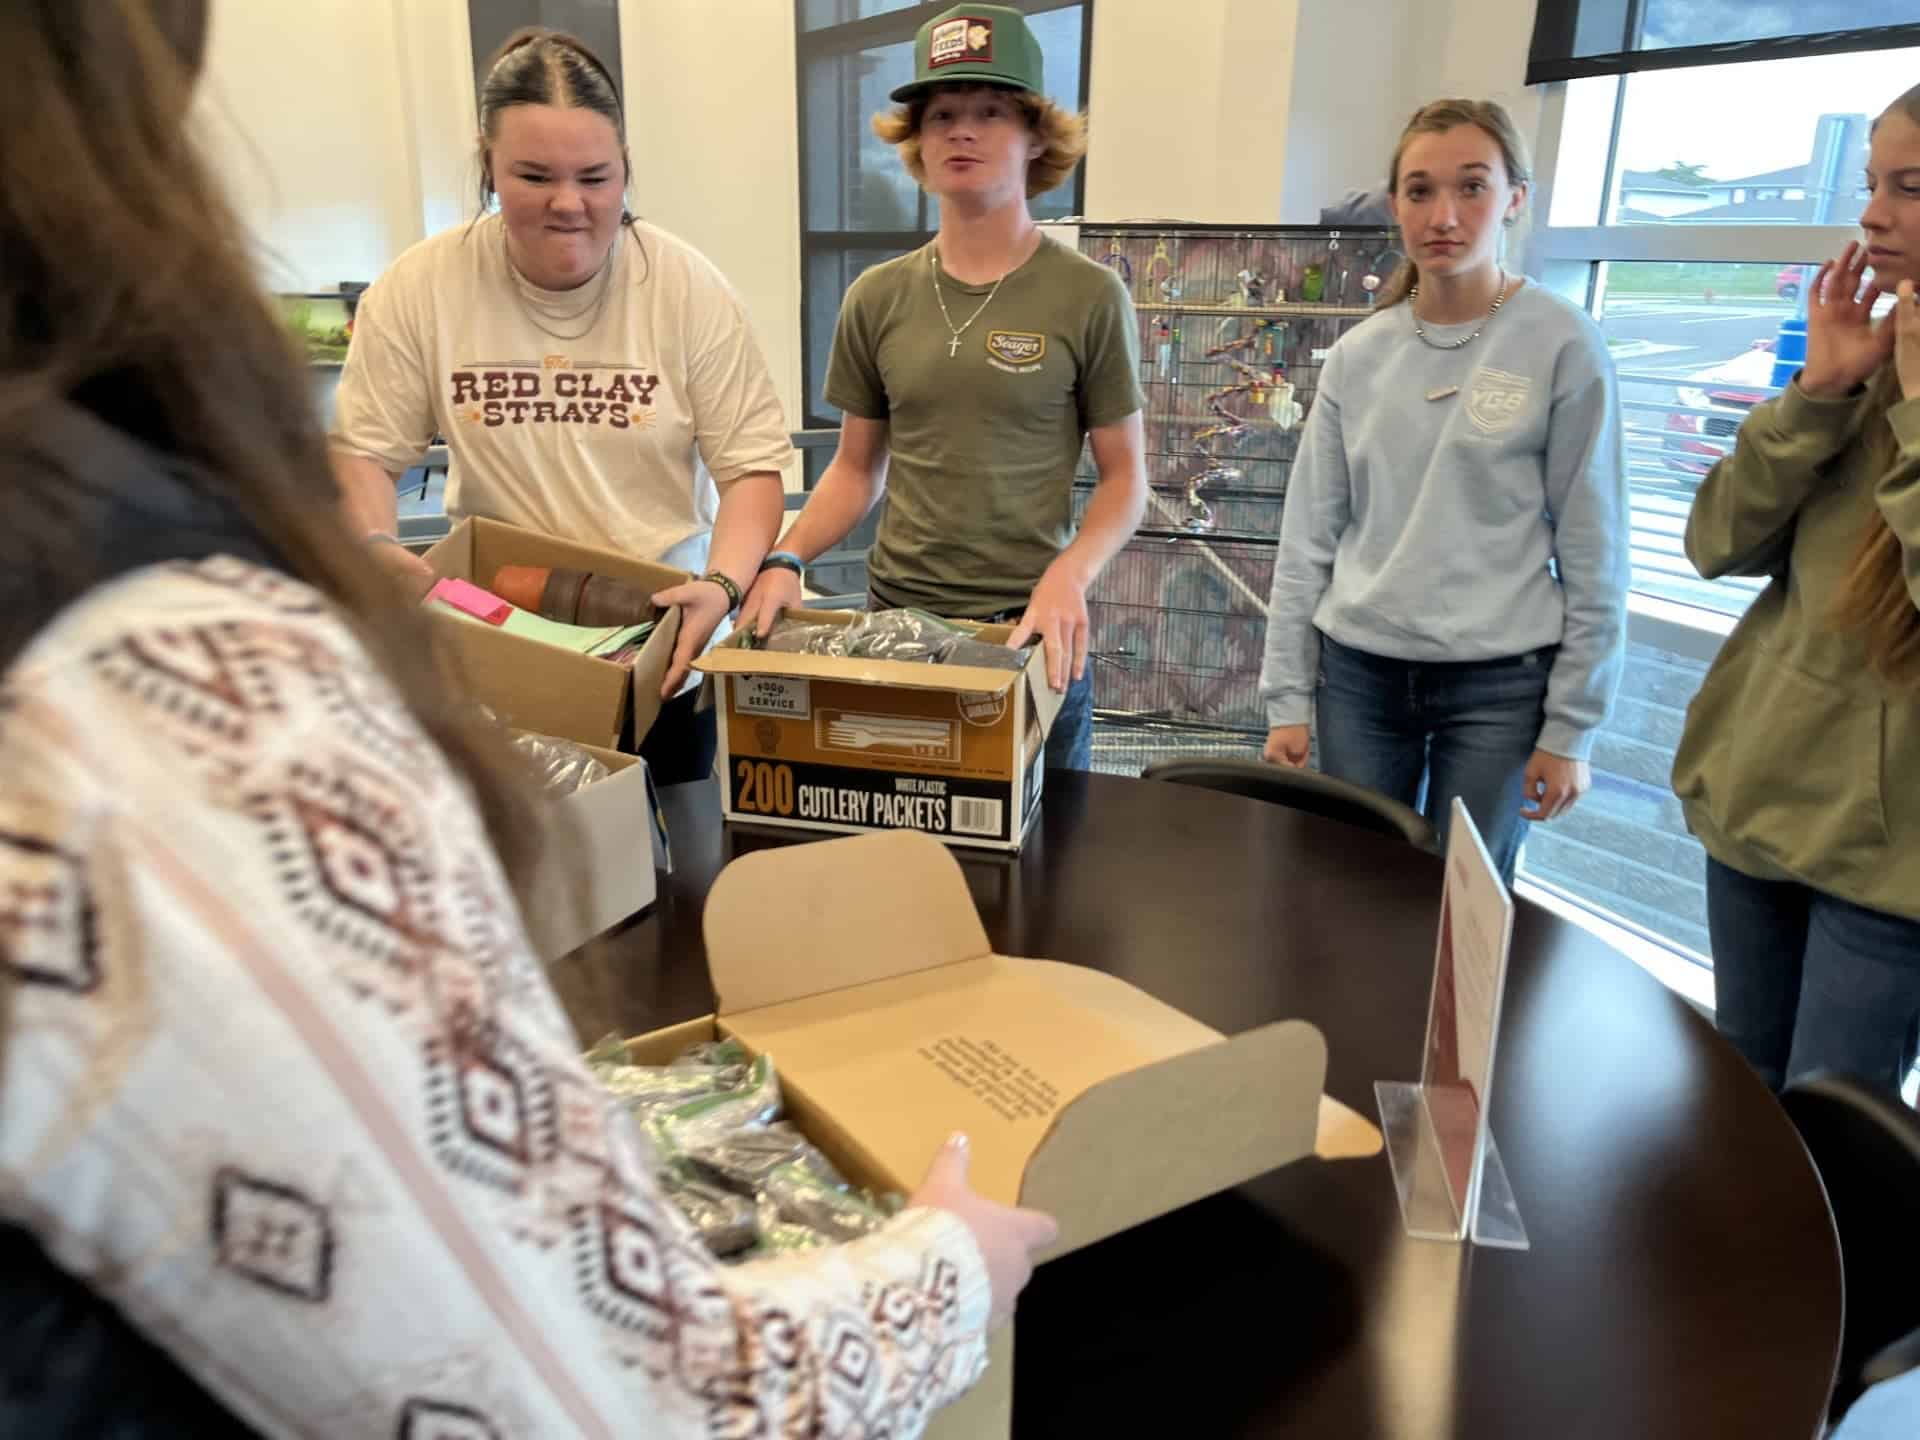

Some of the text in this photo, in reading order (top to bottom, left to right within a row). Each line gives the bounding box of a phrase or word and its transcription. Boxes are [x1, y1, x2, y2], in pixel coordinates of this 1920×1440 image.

[451, 372, 659, 405] RED CLAY
[483, 401, 630, 428] STRAYS
[748, 696, 795, 709] SERVICE
[737, 760, 946, 831] 200 CUTLERY PACKETS
[895, 777, 946, 795] WHITE PLASTIC
